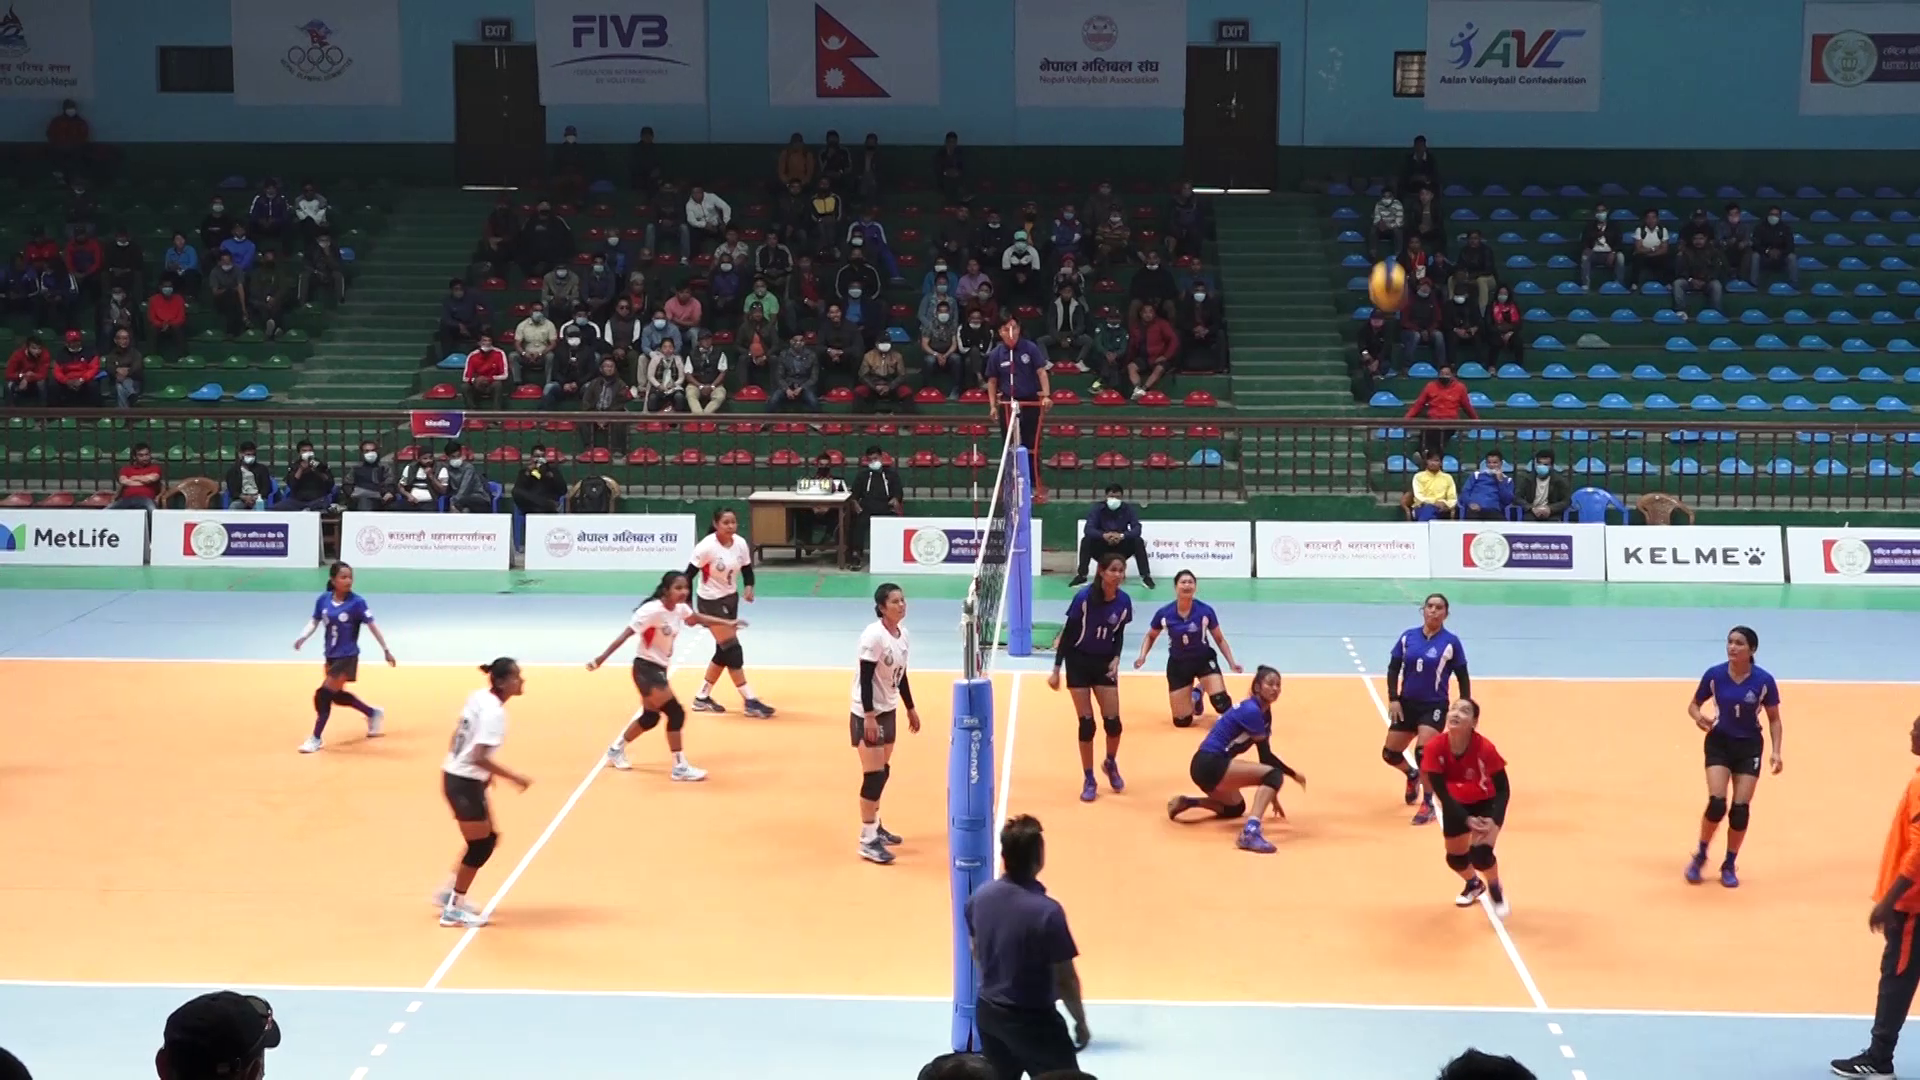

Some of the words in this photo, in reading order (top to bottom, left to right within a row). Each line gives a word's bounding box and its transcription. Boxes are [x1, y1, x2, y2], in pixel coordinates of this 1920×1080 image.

[485, 25, 508, 38] EXIT
[572, 14, 669, 48] FIVB
[1222, 25, 1245, 38] EXIT
[1473, 28, 1587, 68] AVC
[1039, 57, 1078, 72] नेपाल
[1039, 76, 1065, 85] Nepal
[1067, 76, 1108, 86] Volleyball
[1110, 76, 1160, 84] Association
[1440, 76, 1467, 84] Asian
[1469, 75, 1516, 86] Volleyball
[1519, 75, 1587, 84] Confederation
[34, 527, 120, 548] MetLife
[577, 529, 609, 543] नेपाल
[1624, 547, 1740, 565] KELME
[1096, 625, 1108, 640] 11
[1734, 703, 1740, 718] 1
